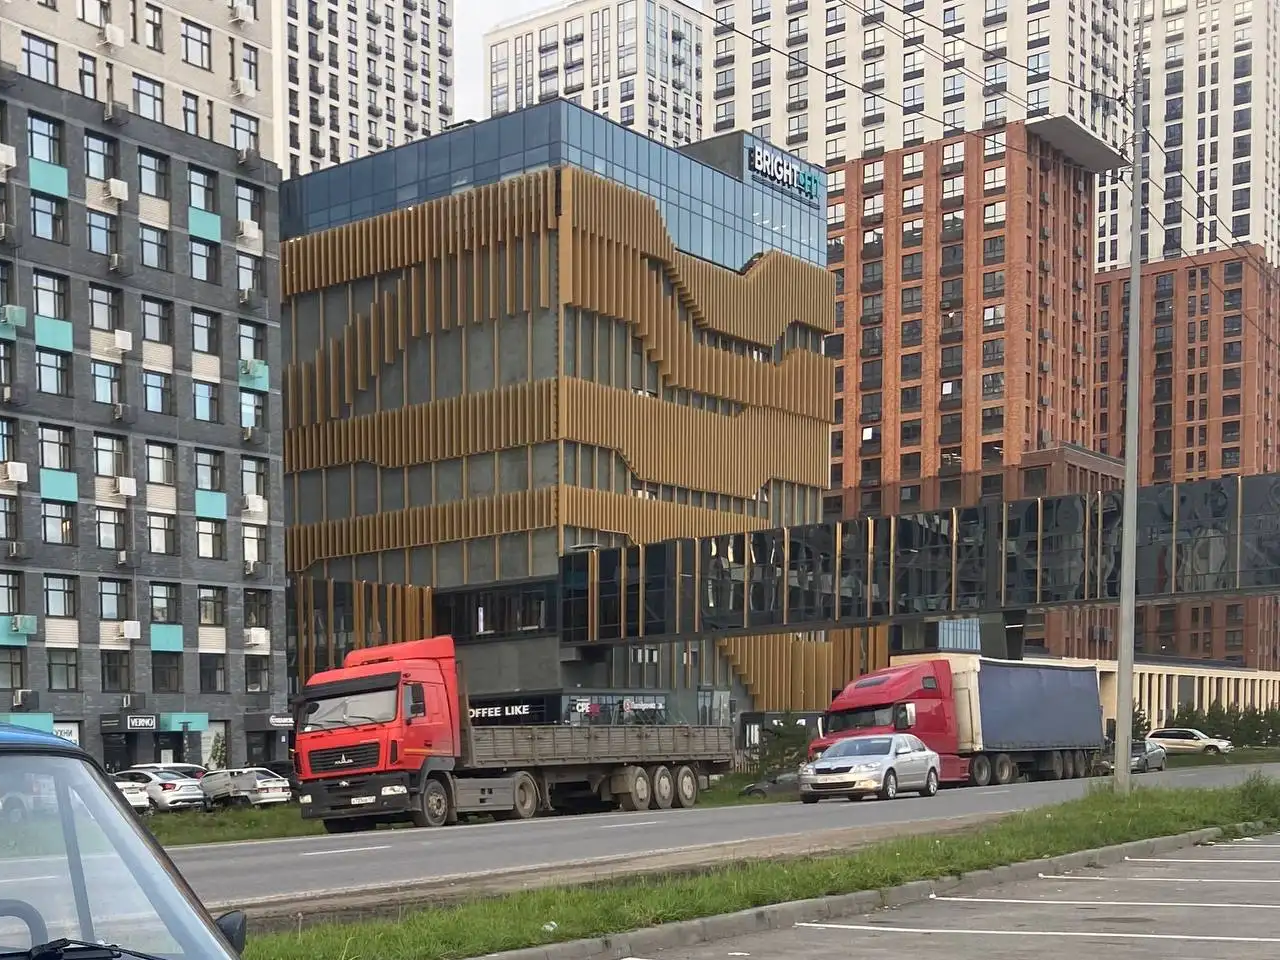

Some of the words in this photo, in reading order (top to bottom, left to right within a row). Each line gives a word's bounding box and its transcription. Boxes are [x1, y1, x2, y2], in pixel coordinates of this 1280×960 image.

[754, 145, 801, 188] BRIGHT
[468, 706, 501, 718] OFFEE
[504, 704, 530, 716] LIKE
[130, 718, 153, 727] VERNO
